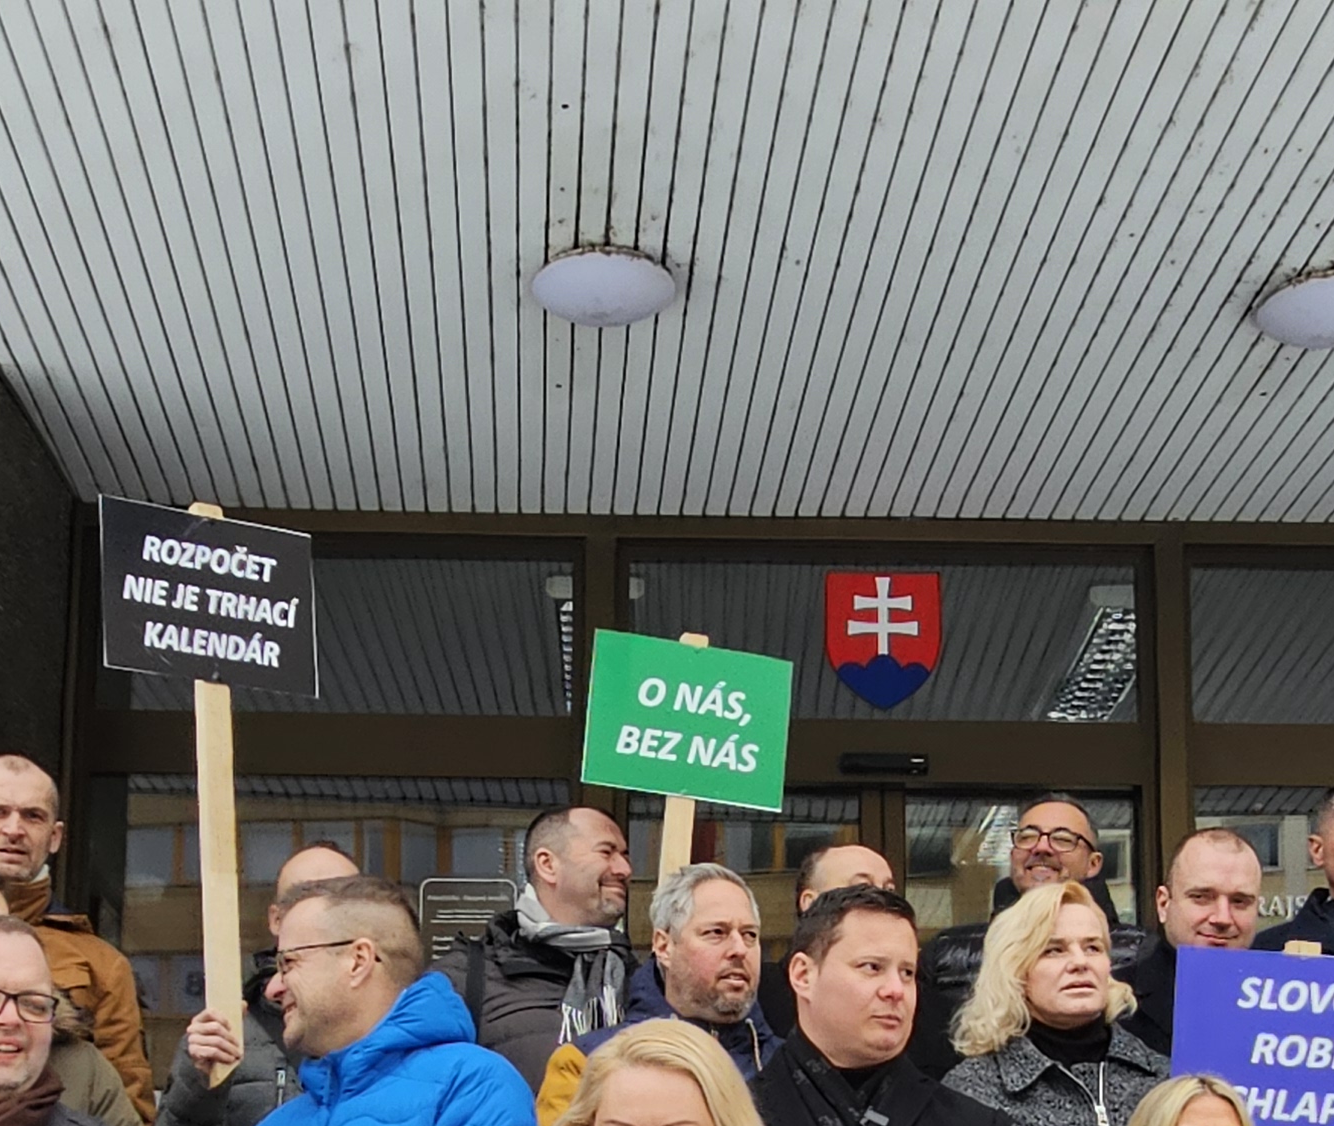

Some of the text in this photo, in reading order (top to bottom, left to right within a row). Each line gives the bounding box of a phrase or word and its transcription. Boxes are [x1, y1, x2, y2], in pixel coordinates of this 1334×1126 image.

[142, 533, 278, 583] ROZPOČET
[122, 573, 300, 630] NIE JE TRHACÍ
[143, 620, 281, 668] KALENDÁR
[638, 677, 752, 727] O NÁS,
[615, 725, 759, 773] BEZ NÁS
